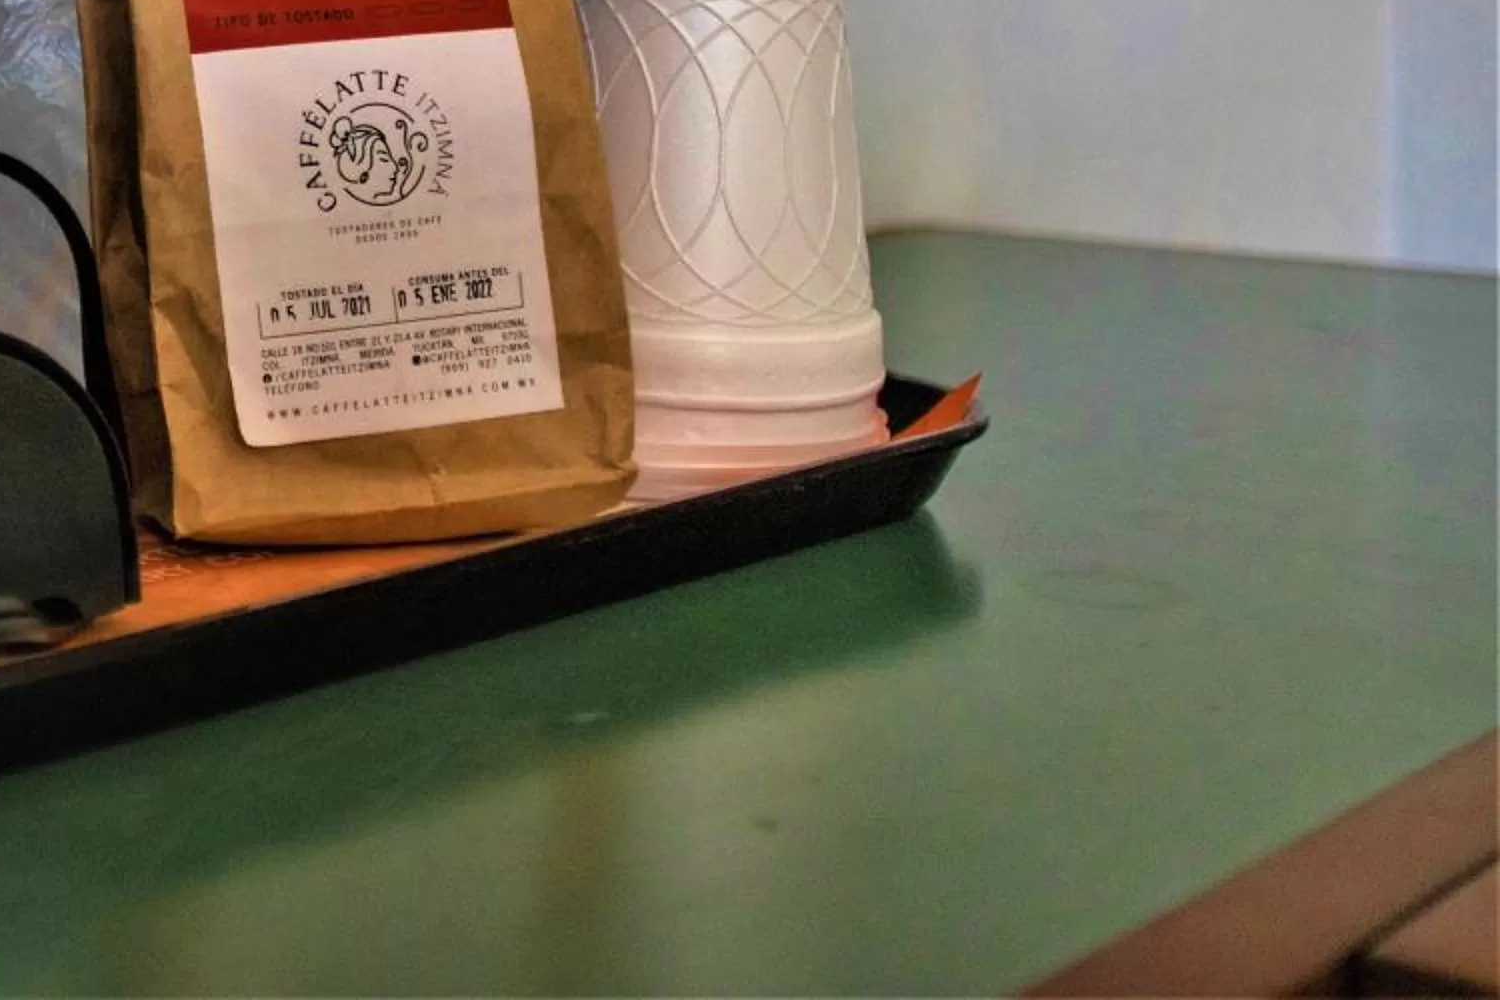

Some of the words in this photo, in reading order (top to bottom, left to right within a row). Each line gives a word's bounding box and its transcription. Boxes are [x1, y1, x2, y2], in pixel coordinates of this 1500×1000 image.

[258, 11, 278, 27] DE
[285, 8, 355, 25] TOSTADO
[408, 273, 455, 286] CONSUMA
[458, 268, 488, 281] ANTES
[491, 266, 509, 277] DEL
[280, 287, 327, 301] TOSTADO
[331, 284, 344, 295] EL
[431, 282, 458, 305] ENE
[464, 277, 493, 300] 2022
[308, 300, 336, 320] JUL
[341, 295, 372, 317] 2021
[261, 346, 288, 358] CALLE
